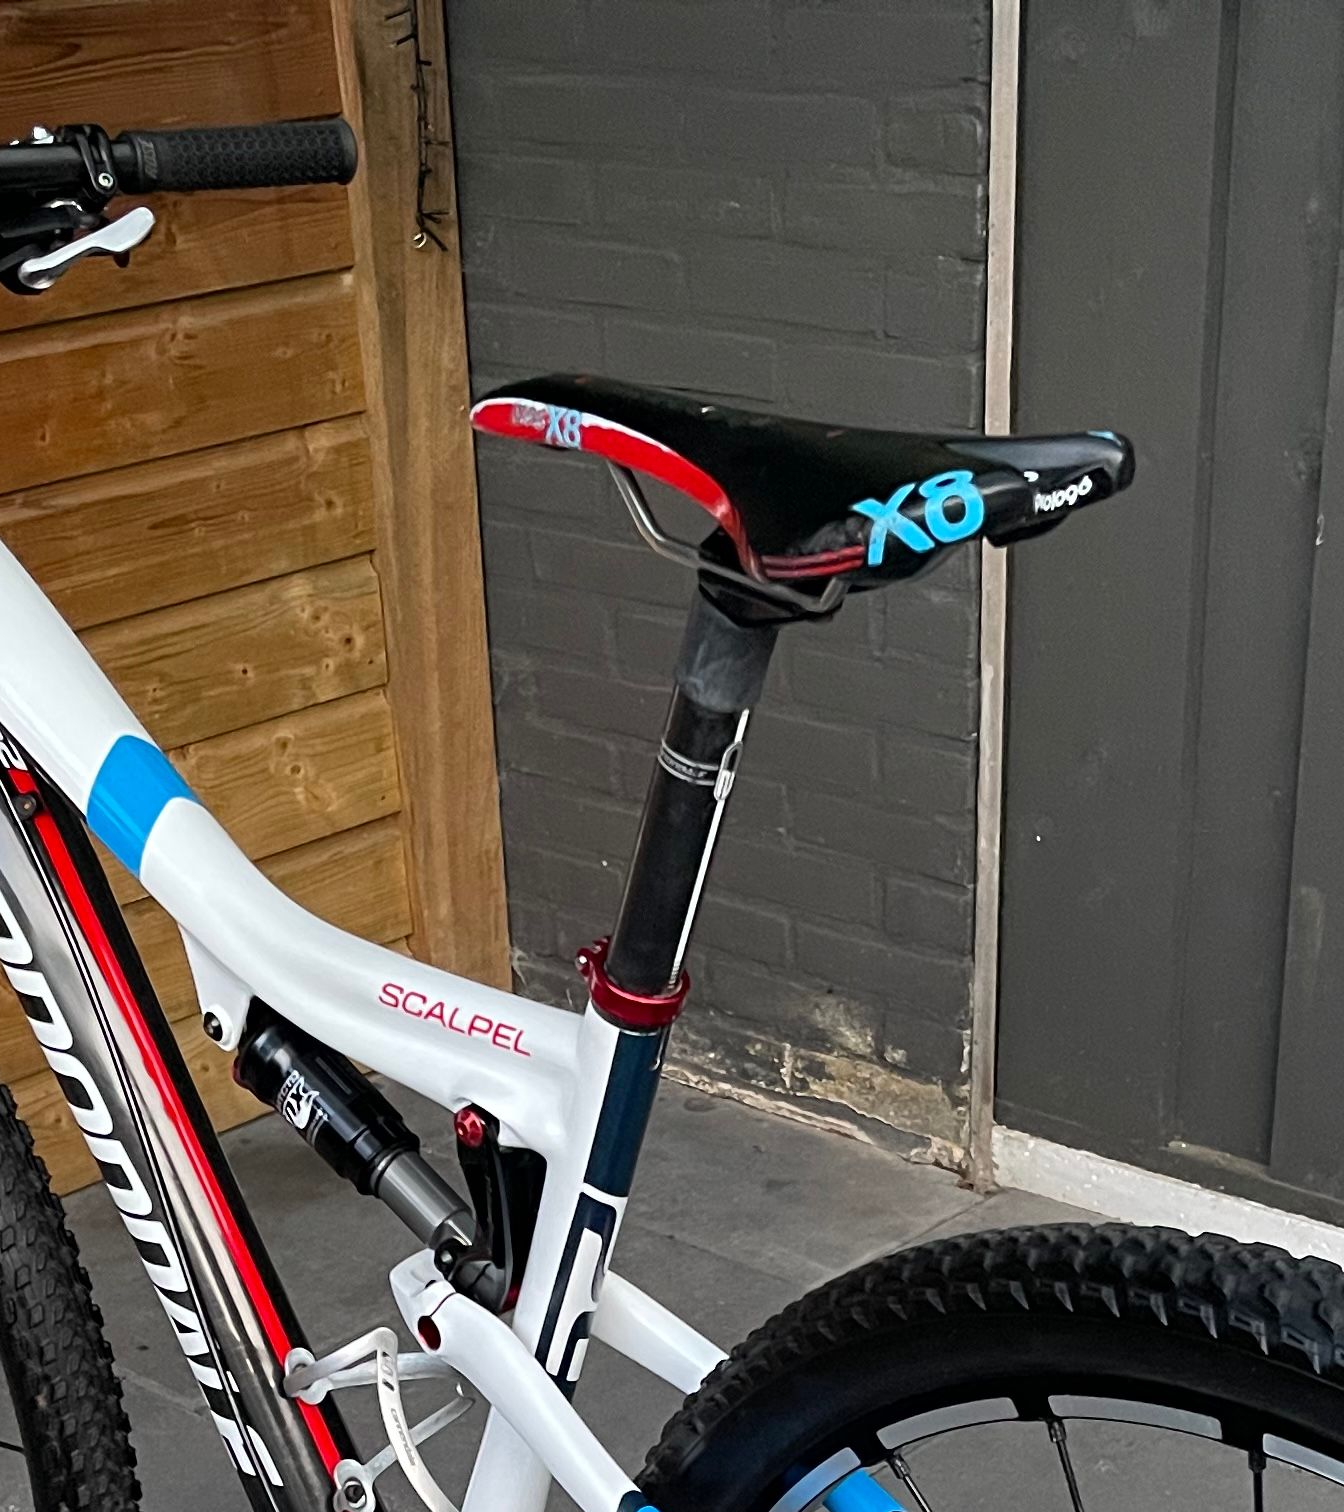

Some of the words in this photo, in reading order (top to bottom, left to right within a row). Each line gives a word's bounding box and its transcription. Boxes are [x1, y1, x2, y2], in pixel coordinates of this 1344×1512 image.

[545, 403, 582, 449] X8
[850, 470, 985, 567] X8
[379, 983, 531, 1056] SCALPEL
